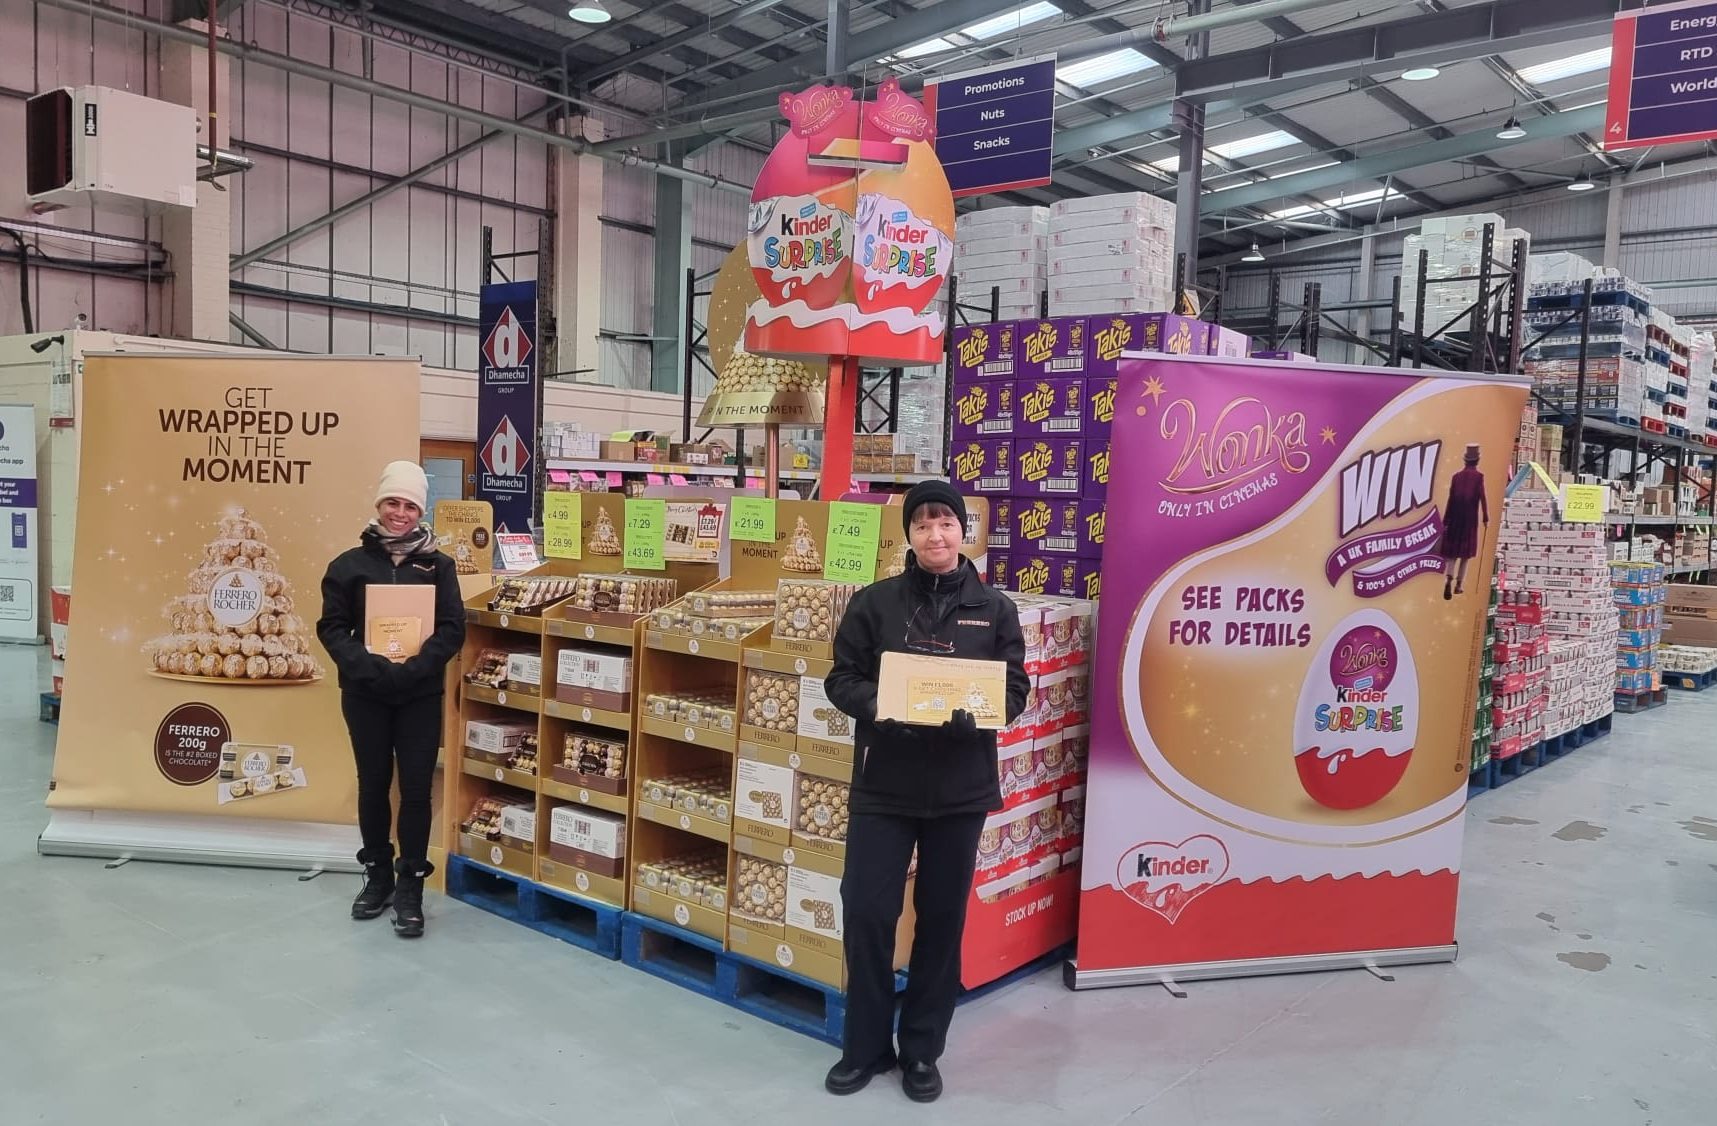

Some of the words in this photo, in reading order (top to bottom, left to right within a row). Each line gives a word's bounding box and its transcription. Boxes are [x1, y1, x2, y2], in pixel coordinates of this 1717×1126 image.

[1670, 15, 1717, 31] Energ
[1680, 47, 1713, 61] RTD
[964, 75, 1025, 96] Promotions
[793, 90, 844, 126] Wonka
[878, 93, 928, 136] Wonka
[980, 108, 1005, 121] Nuts
[1609, 122, 1622, 134] 4
[973, 135, 1010, 151] Snacks
[763, 228, 843, 270] SURPRISE
[863, 234, 938, 277] SURPRISE
[956, 334, 990, 367] Takis
[1023, 329, 1058, 362] Takis
[1094, 325, 1133, 360] Takis
[488, 369, 525, 381] Dhamecha
[225, 387, 273, 409] GET
[725, 406, 746, 415] THE
[749, 405, 804, 415] MOMENT
[956, 392, 988, 424] Takis
[1021, 390, 1055, 422] Takis
[1091, 390, 1116, 421] Tak
[159, 409, 294, 435] WRAPPED
[301, 411, 340, 436] UP
[208, 435, 231, 457] IN
[238, 436, 286, 458] THE
[1160, 397, 1311, 488] Wonka
[182, 458, 312, 485] MOMENT
[954, 450, 985, 481] Takis
[1019, 449, 1053, 480] Takis
[486, 478, 523, 488] Dhamecha
[1158, 500, 1191, 517] ONLY
[1195, 499, 1215, 517] IN
[1219, 473, 1278, 510] CINEMAS
[1341, 441, 1440, 537] WIN
[1018, 508, 1052, 538] Takis
[742, 547, 778, 559] MOMENT
[1336, 553, 1347, 567] A
[1347, 545, 1363, 560] UK
[1365, 537, 1402, 554] FAMILY
[1404, 523, 1437, 548] BREAK
[1016, 567, 1050, 592] Takis
[1387, 575, 1396, 585] OF
[1397, 563, 1418, 579] OTHER
[1419, 559, 1442, 570] PRIZES
[214, 589, 258, 601] FERRERO
[214, 599, 257, 610] ROCHER
[1181, 585, 1222, 611] SEE
[1236, 587, 1305, 613] PACKS
[1169, 620, 1212, 647] FOR
[1225, 621, 1312, 648] DETAILS
[785, 641, 813, 653] FERRERO
[1339, 643, 1389, 675] Wonka
[1314, 703, 1404, 733] SURPRISE
[168, 724, 221, 738] FERRERO
[754, 731, 781, 744] FERRERO
[164, 749, 171, 757] IS
[172, 750, 185, 758] THE
[196, 751, 218, 759] BOXED
[178, 738, 207, 751] 200g
[812, 743, 840, 756] FERRERO
[747, 824, 774, 838] FERRERO
[1005, 906, 1026, 926] STOCK
[1027, 902, 1037, 916] UP
[800, 934, 827, 949] FERRERO
